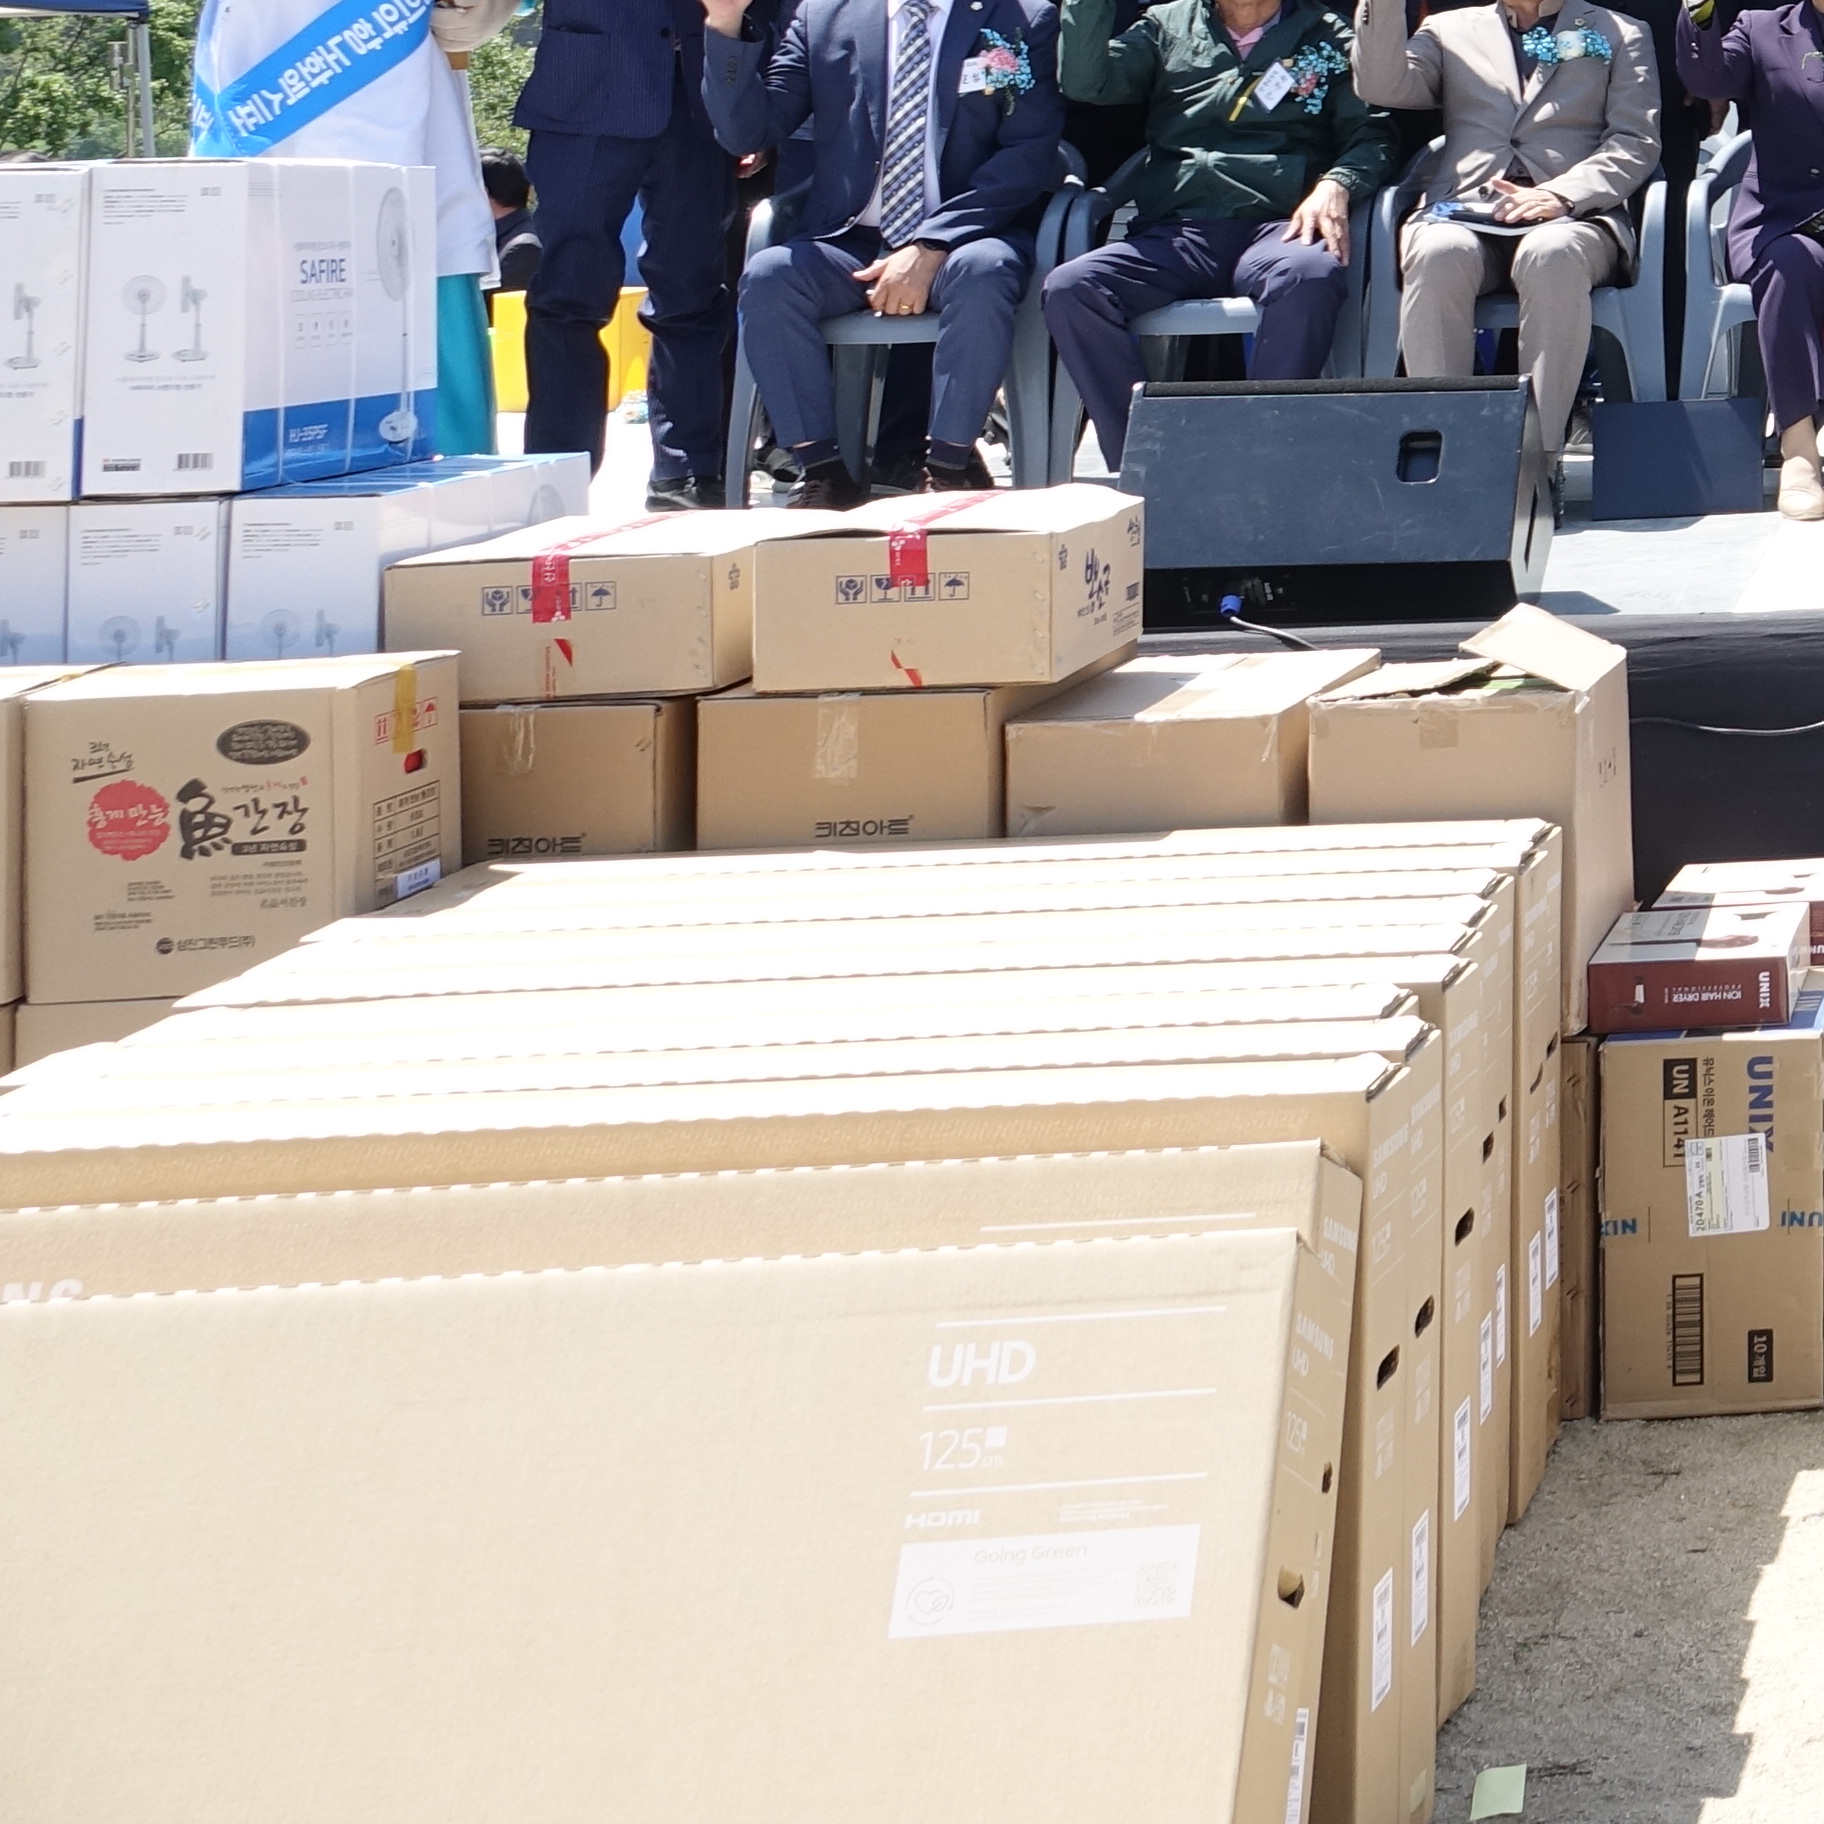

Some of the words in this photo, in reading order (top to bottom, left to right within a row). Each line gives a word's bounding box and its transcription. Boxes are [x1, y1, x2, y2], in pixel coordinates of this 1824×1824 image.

[300, 258, 346, 284] SAFIRE
[1672, 992, 1700, 1003] DRYER
[1700, 991, 1722, 1001] HAIR
[1723, 990, 1742, 1000] ION
[1758, 972, 1770, 1008] UNIX
[1672, 1065, 1689, 1094] UN
[928, 1340, 1036, 1388] UHD
[1753, 1335, 1767, 1378] 10개입
[904, 1509, 981, 1529] HDMI
[973, 1546, 1027, 1565] Going
[1032, 1543, 1088, 1560] Green
